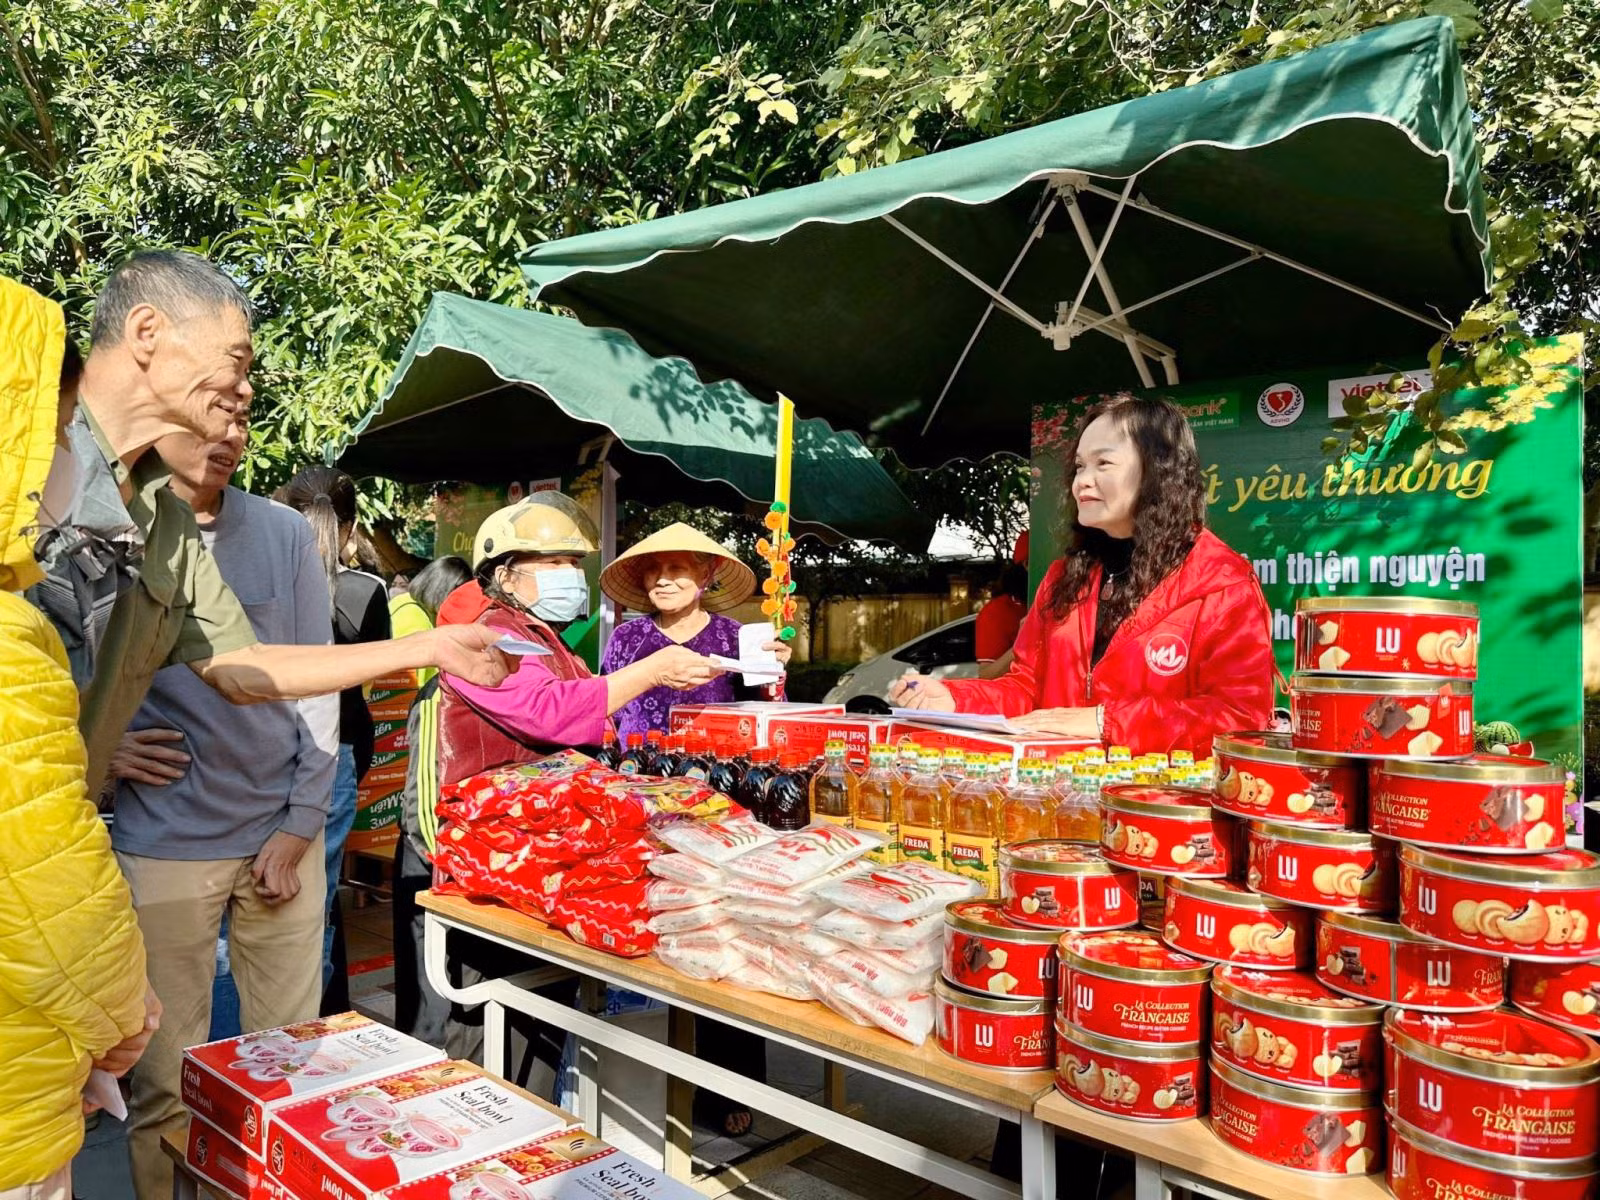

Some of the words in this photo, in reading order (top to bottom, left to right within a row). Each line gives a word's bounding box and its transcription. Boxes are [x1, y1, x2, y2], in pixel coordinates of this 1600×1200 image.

[1341, 378, 1421, 400] vietel
[1228, 464, 1308, 512] yêu
[1321, 459, 1494, 499] thương
[1287, 550, 1360, 591] thiện
[1370, 547, 1485, 590] nguyện
[1376, 627, 1401, 653] LU
[374, 722, 392, 737] iền
[1458, 710, 1471, 736] LU
[846, 743, 867, 755] Fres
[1028, 748, 1046, 759] Fresh
[904, 837, 929, 849] FREDA
[953, 846, 980, 858] FREDA
[1278, 855, 1298, 881] LU
[1104, 887, 1121, 909] LU
[1417, 882, 1437, 915] LU
[1196, 913, 1215, 937] LU
[1039, 957, 1055, 979] LU
[1427, 960, 1451, 987] LU
[1077, 984, 1094, 1011] LU
[1135, 1000, 1144, 1011] LA
[368, 1029, 398, 1044] Fresh
[975, 1024, 994, 1048] LU
[184, 1064, 200, 1083] Fresh
[474, 1085, 508, 1107] Fresh
[1419, 1077, 1442, 1112] LU
[454, 1090, 481, 1112] Seal
[478, 1102, 513, 1124] bowl
[1502, 1103, 1514, 1118] LA
[1517, 1105, 1575, 1118] COLLECTION
[1392, 1144, 1406, 1178] LU
[592, 1169, 629, 1190] Seal
[612, 1161, 655, 1188] Fresh
